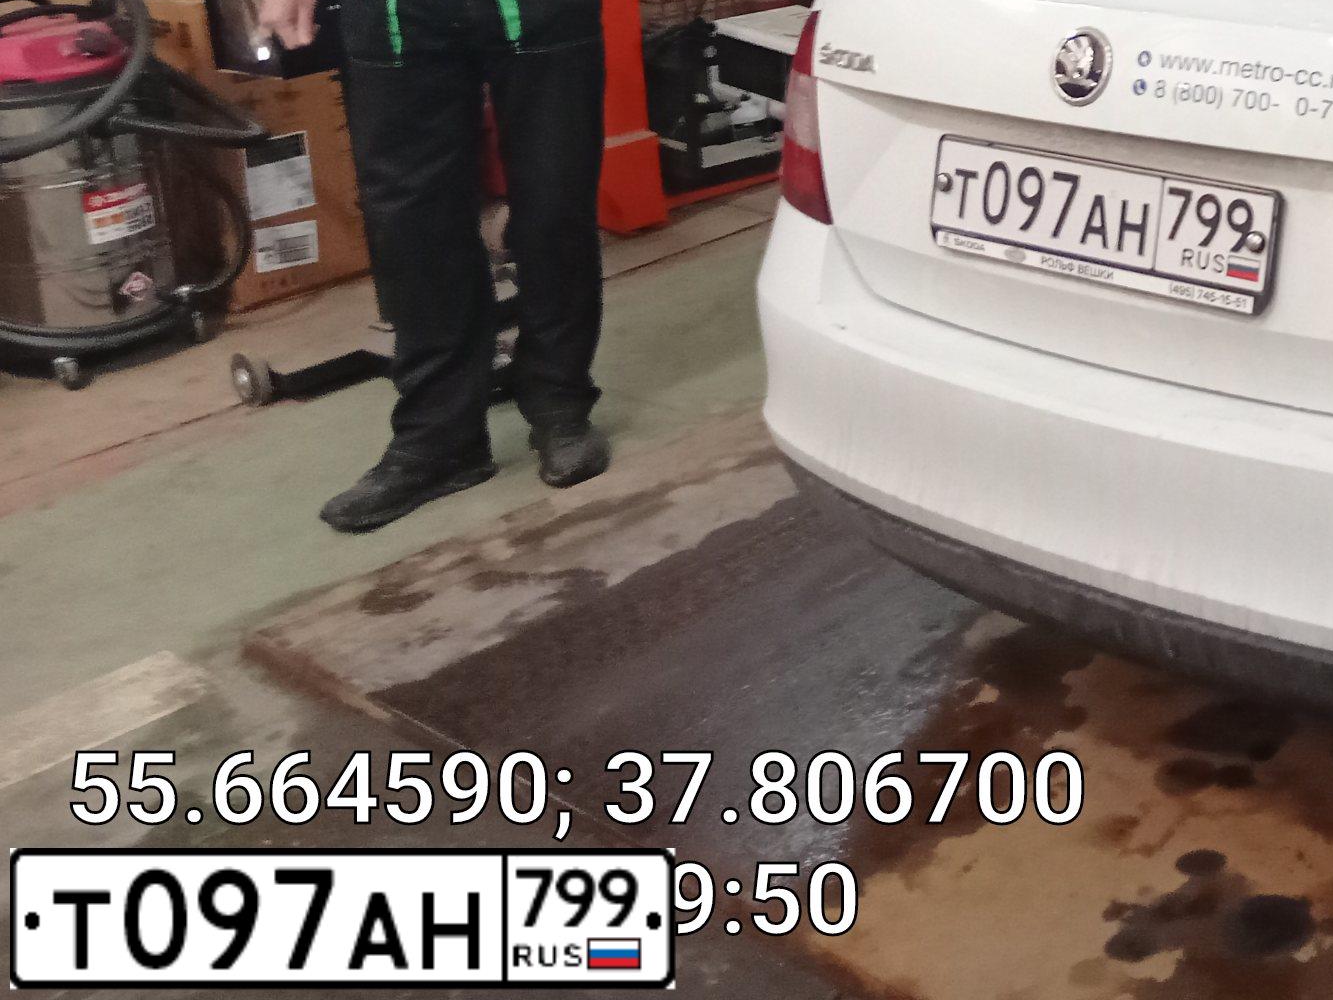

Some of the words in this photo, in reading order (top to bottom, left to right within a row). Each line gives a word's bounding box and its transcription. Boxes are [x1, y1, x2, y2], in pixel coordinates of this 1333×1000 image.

[1154, 79, 1167, 99] 8
[1172, 81, 1224, 109] (800)
[1167, 186, 1255, 253] 799
[1180, 248, 1225, 274] RUS
